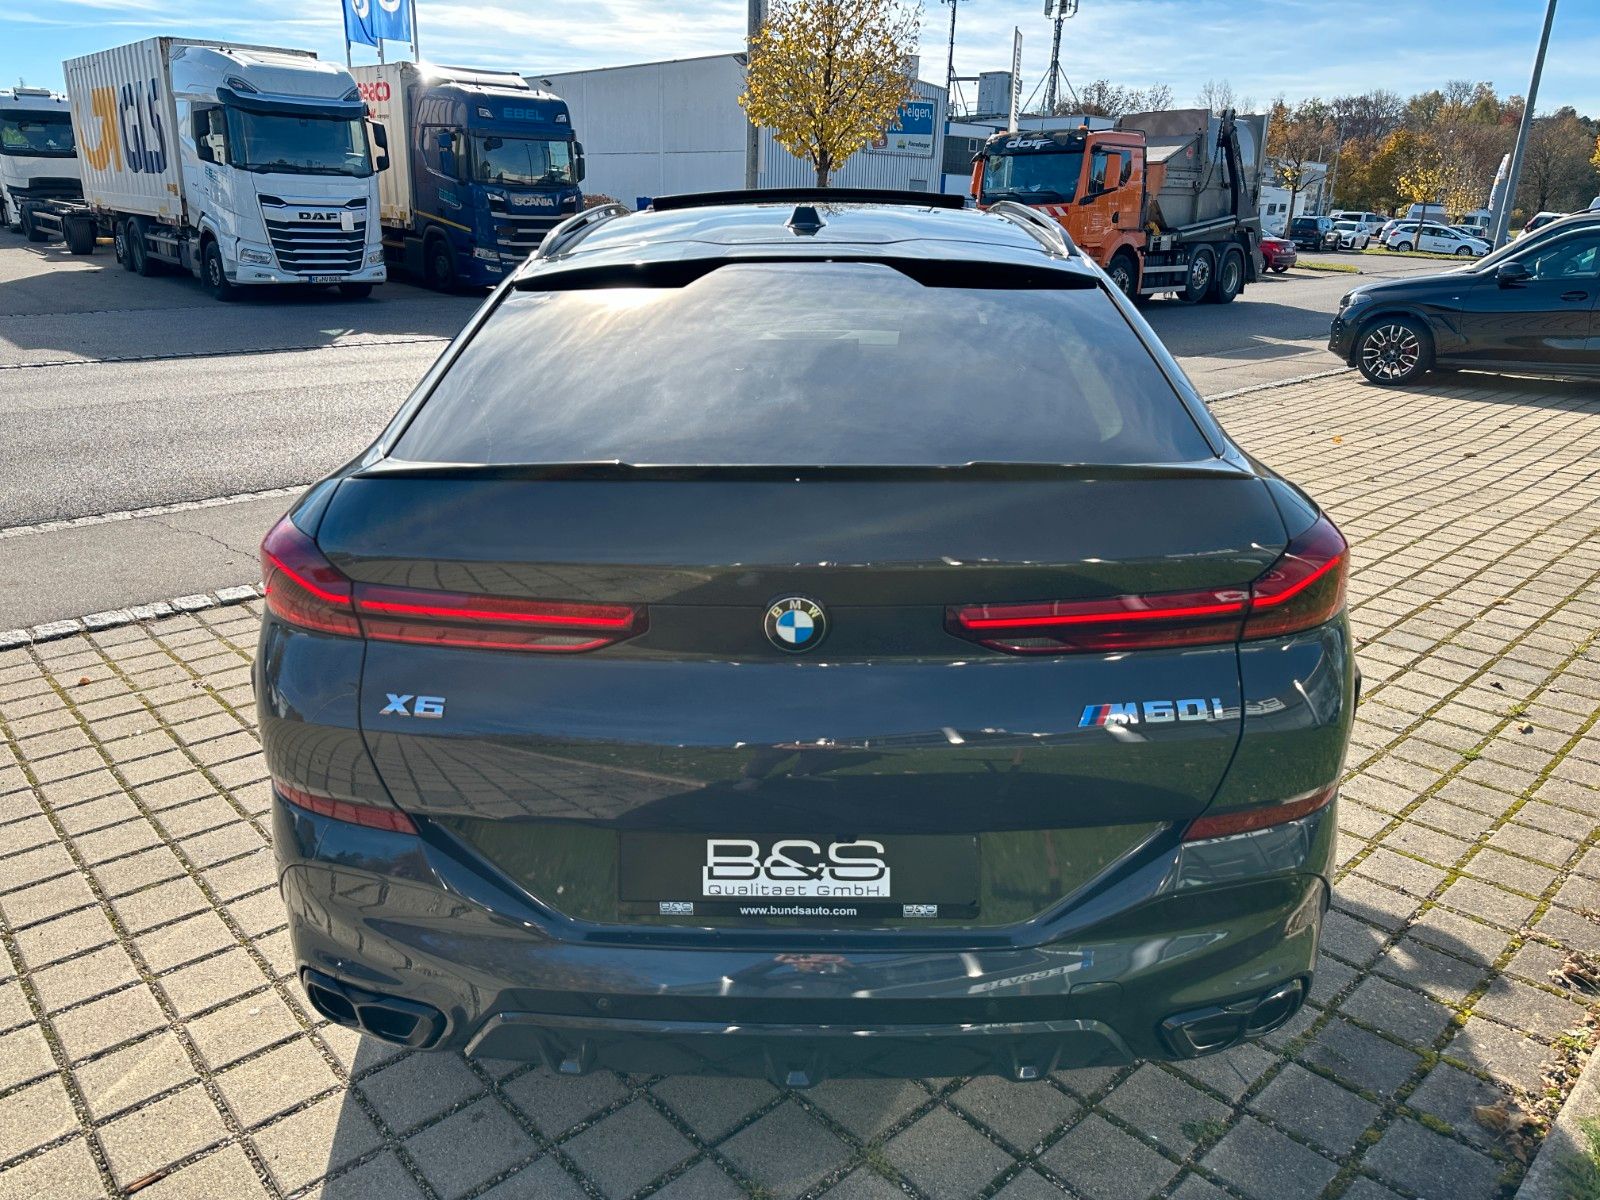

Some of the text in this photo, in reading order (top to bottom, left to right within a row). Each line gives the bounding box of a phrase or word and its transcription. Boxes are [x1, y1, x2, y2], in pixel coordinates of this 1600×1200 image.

[503, 107, 545, 121] EBEL
[119, 77, 167, 174] GLS
[513, 197, 555, 208] SCANIA
[298, 211, 338, 221] DAF
[771, 600, 821, 618] BMW
[379, 693, 446, 719] X6
[707, 839, 886, 881] B&S
[708, 883, 807, 896] Qualitaet
[740, 905, 858, 916] www.bundsauto.com
